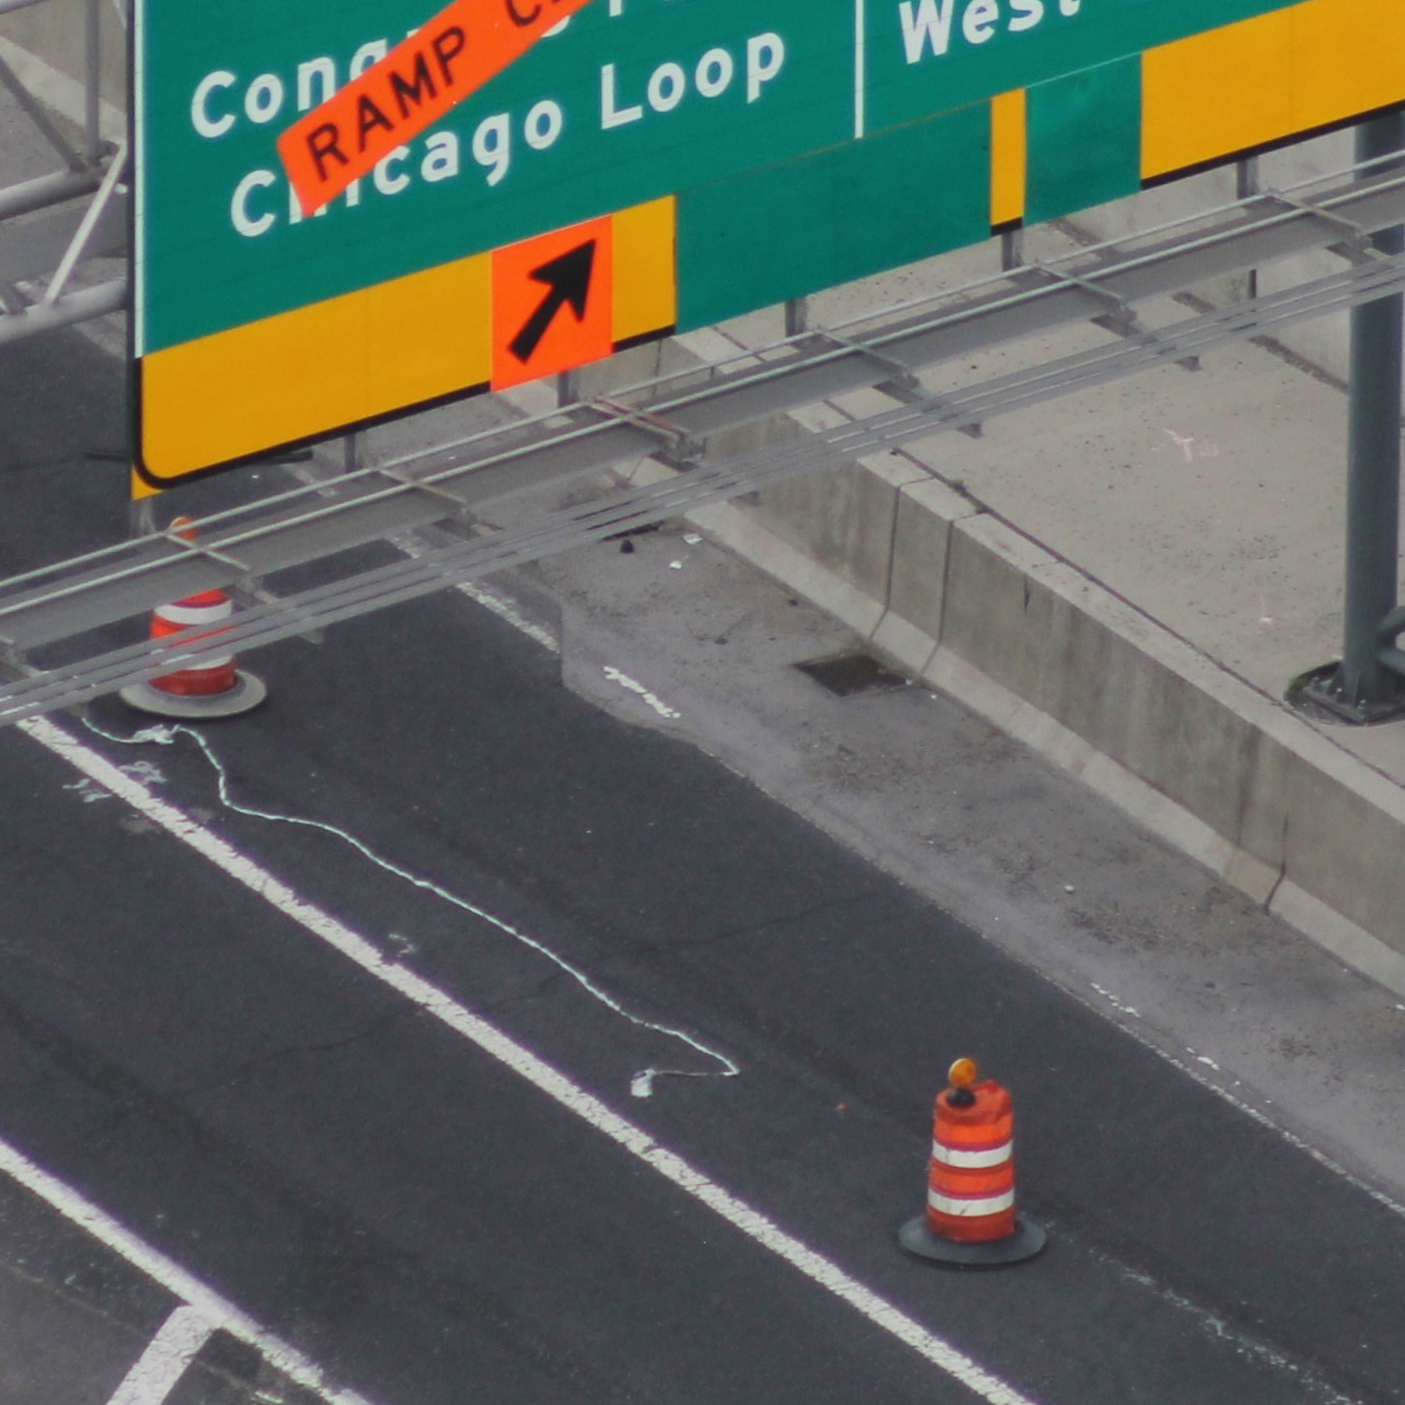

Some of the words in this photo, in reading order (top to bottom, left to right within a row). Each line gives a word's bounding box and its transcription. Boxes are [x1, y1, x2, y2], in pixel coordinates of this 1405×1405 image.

[230, 99, 563, 237] Ccago
[600, 31, 785, 131] Loop
[305, 25, 466, 183] RAMP
